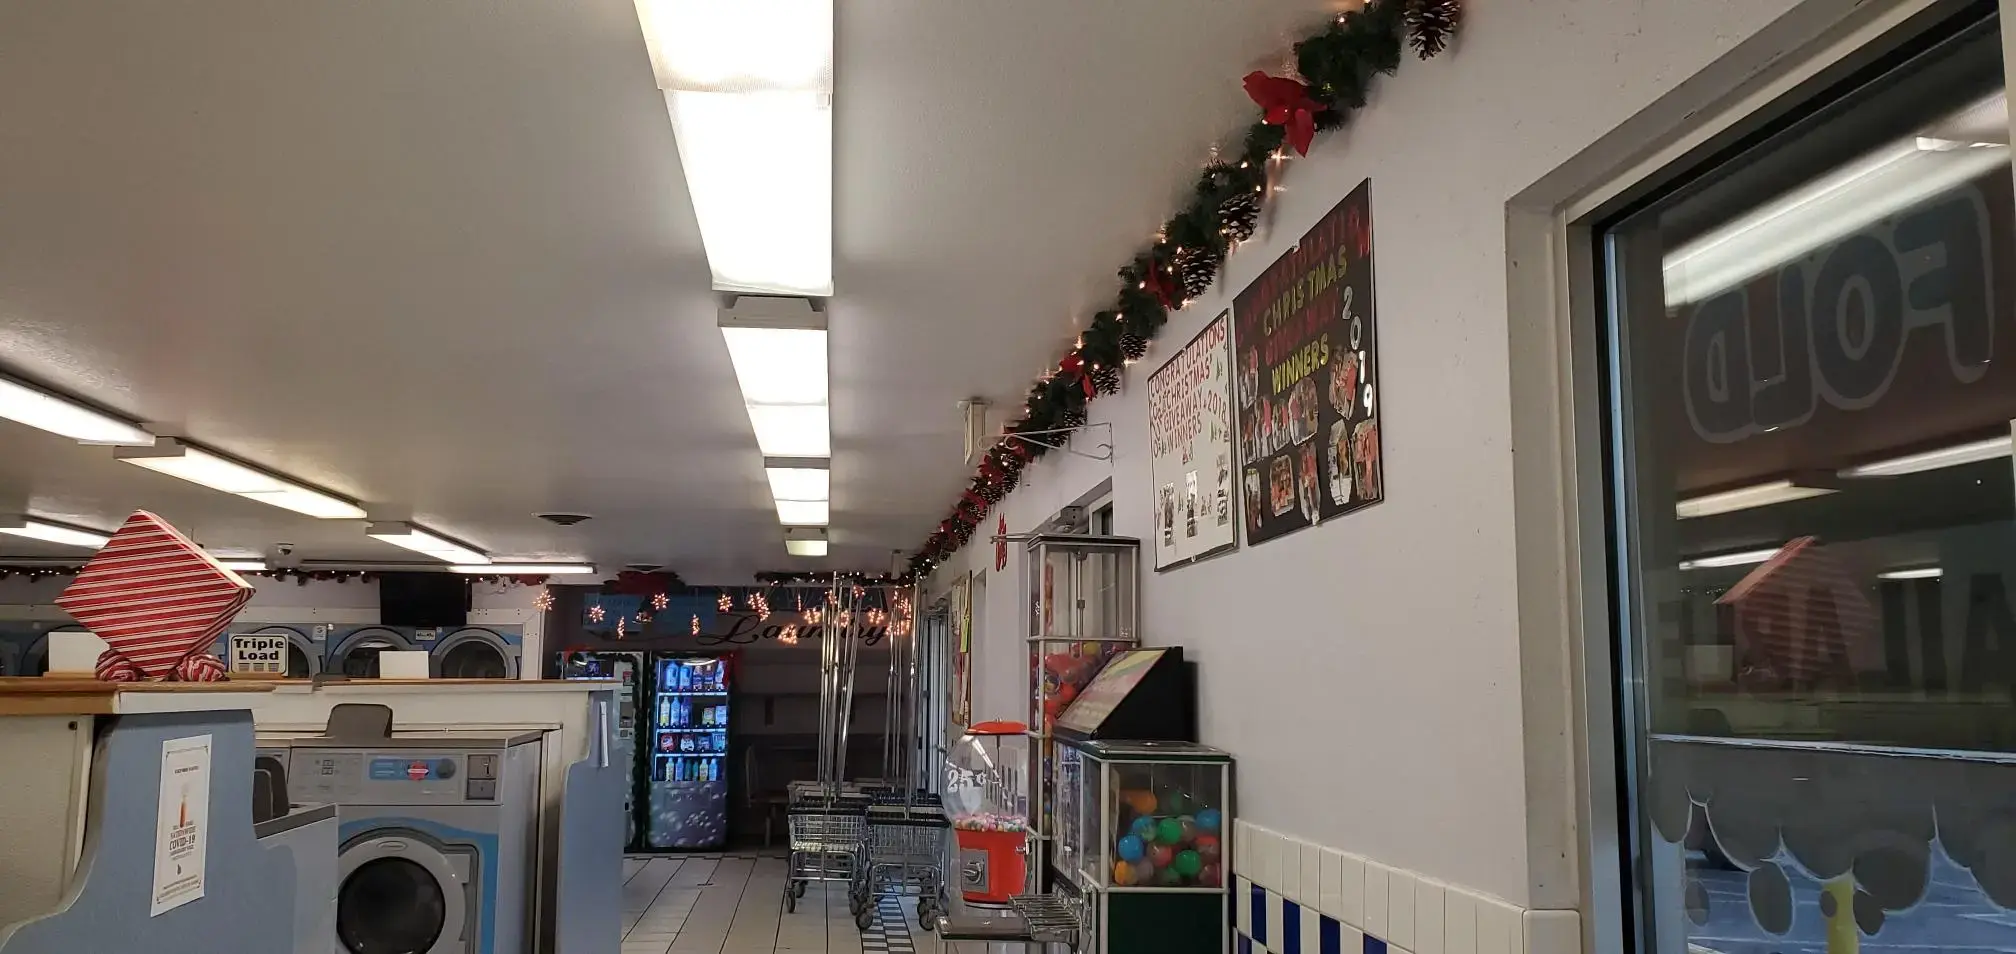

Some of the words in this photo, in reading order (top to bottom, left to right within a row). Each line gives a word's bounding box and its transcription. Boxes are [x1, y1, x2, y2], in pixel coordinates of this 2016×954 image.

[1263, 244, 1347, 336] CHRISTMAS
[1150, 317, 1225, 398] CONGRATULATIONS
[1271, 332, 1329, 396] WINNERS
[1342, 286, 1373, 417] 2019
[1164, 387, 1202, 432] GIVEAWAY
[1207, 389, 1227, 425] 2018
[1167, 412, 1202, 455] WINNERS
[233, 638, 284, 651] Triple
[238, 650, 279, 660] Load
[169, 834, 196, 851] COVID-19
